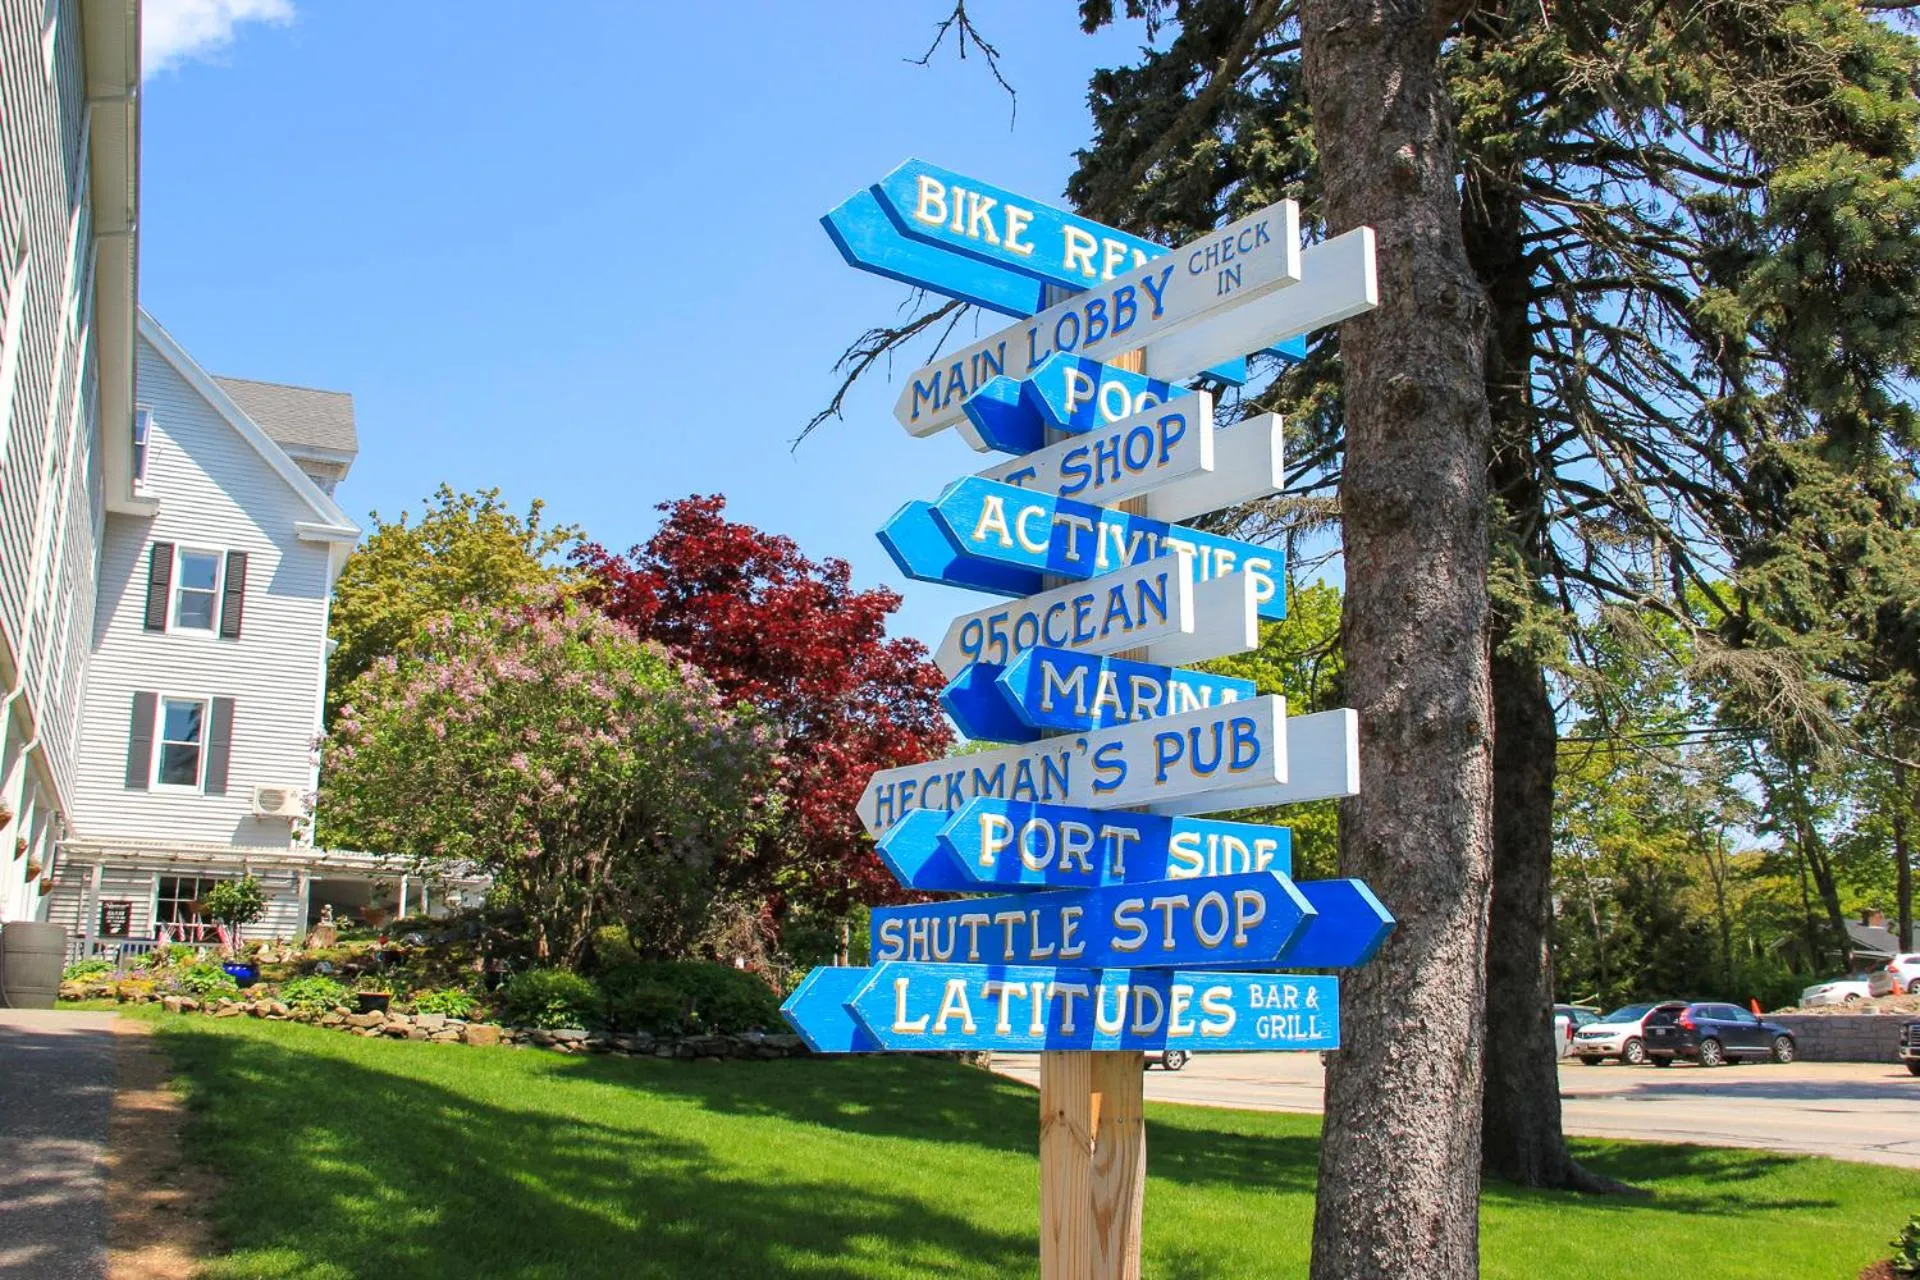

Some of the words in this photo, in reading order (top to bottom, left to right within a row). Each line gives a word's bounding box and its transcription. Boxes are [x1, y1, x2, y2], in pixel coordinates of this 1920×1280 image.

[914, 174, 1035, 256] BIKE
[1188, 220, 1271, 276] CHECK
[1217, 263, 1242, 296] IN
[910, 341, 1007, 422] MAIN
[1026, 263, 1176, 374] LOBBY
[1058, 412, 1188, 498] SHOP
[874, 737, 1129, 828] HECKMAN'S
[1154, 716, 1263, 785] PUB
[979, 811, 1141, 876] PORT
[1167, 831, 1278, 880] SIDE
[877, 905, 1087, 963] SHUTTLE
[1110, 888, 1267, 953] STOP
[892, 976, 1238, 1036] LATITUDES
[1249, 983, 1299, 1009] BAR
[1305, 985, 1320, 1011] &
[1256, 1014, 1323, 1040] GRILL
